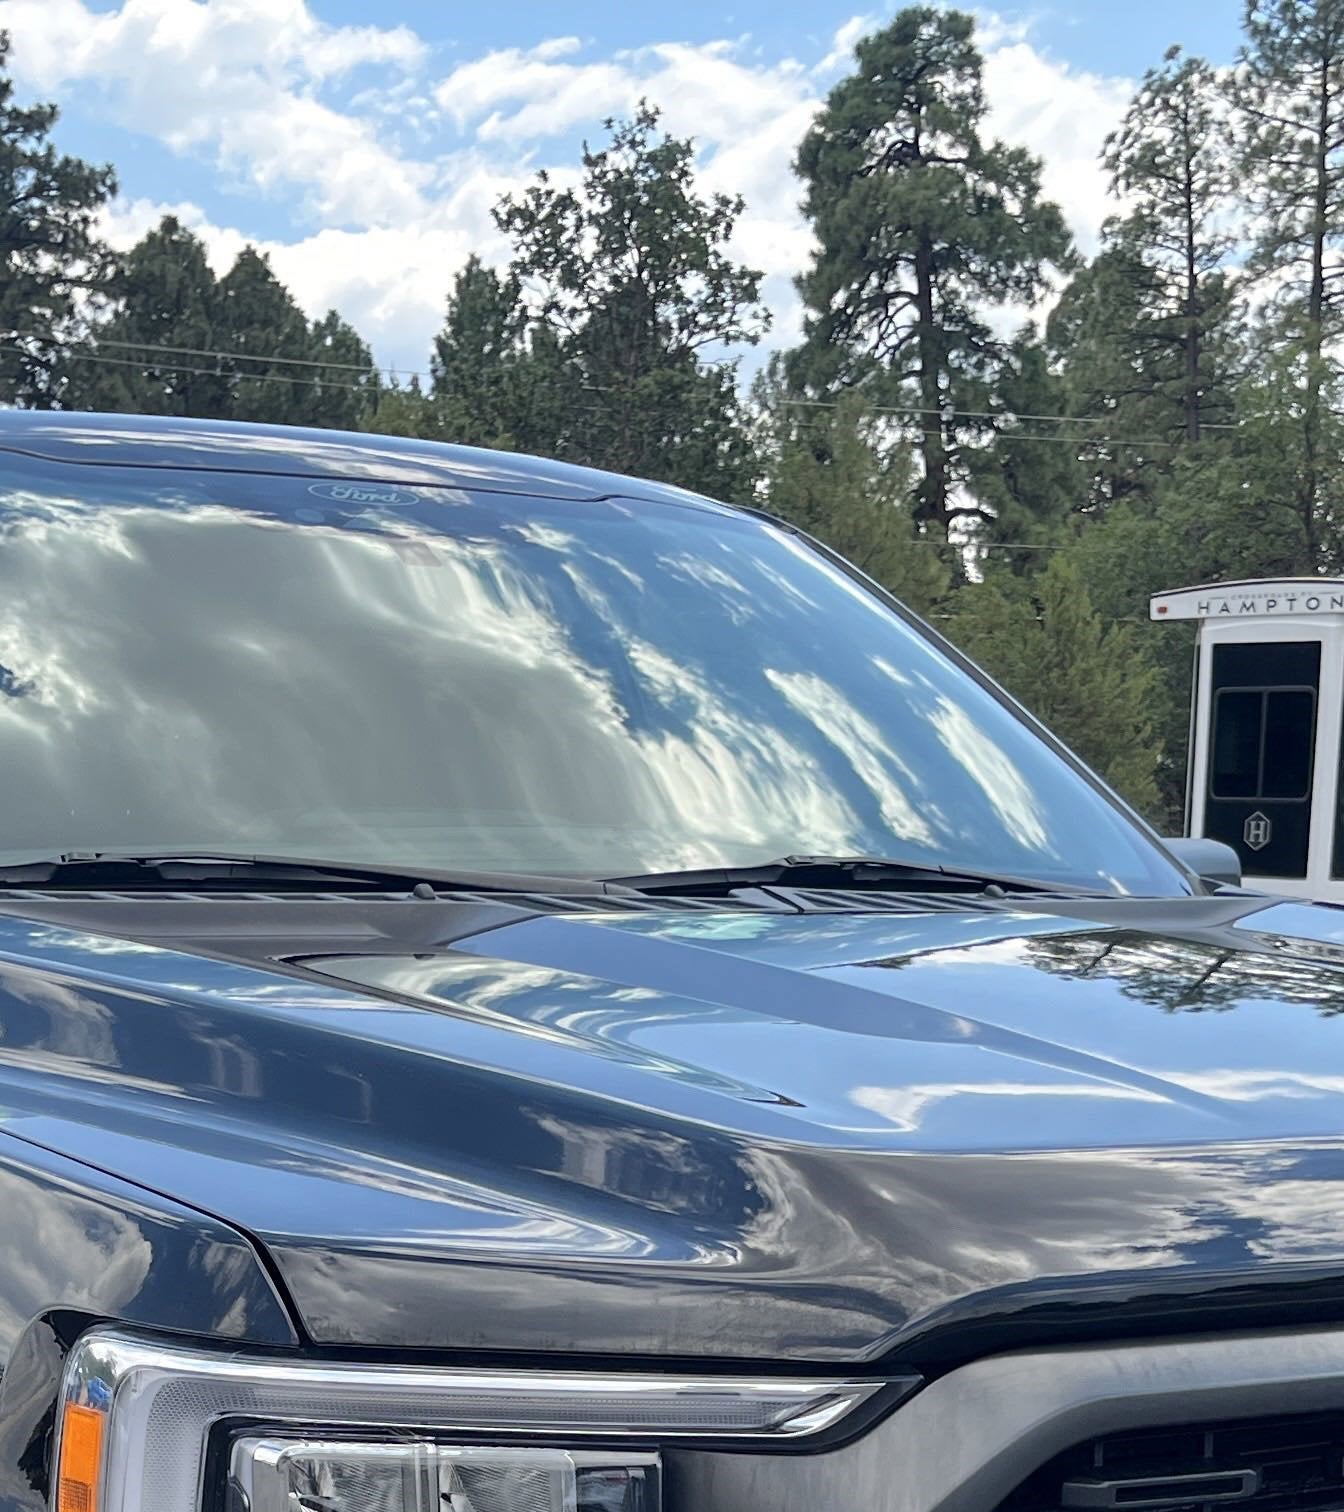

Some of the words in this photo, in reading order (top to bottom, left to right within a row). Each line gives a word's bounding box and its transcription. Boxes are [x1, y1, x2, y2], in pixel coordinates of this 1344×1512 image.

[330, 485, 401, 504] Ford
[1197, 595, 1344, 615] HAMPTON
[1248, 820, 1266, 843] H
